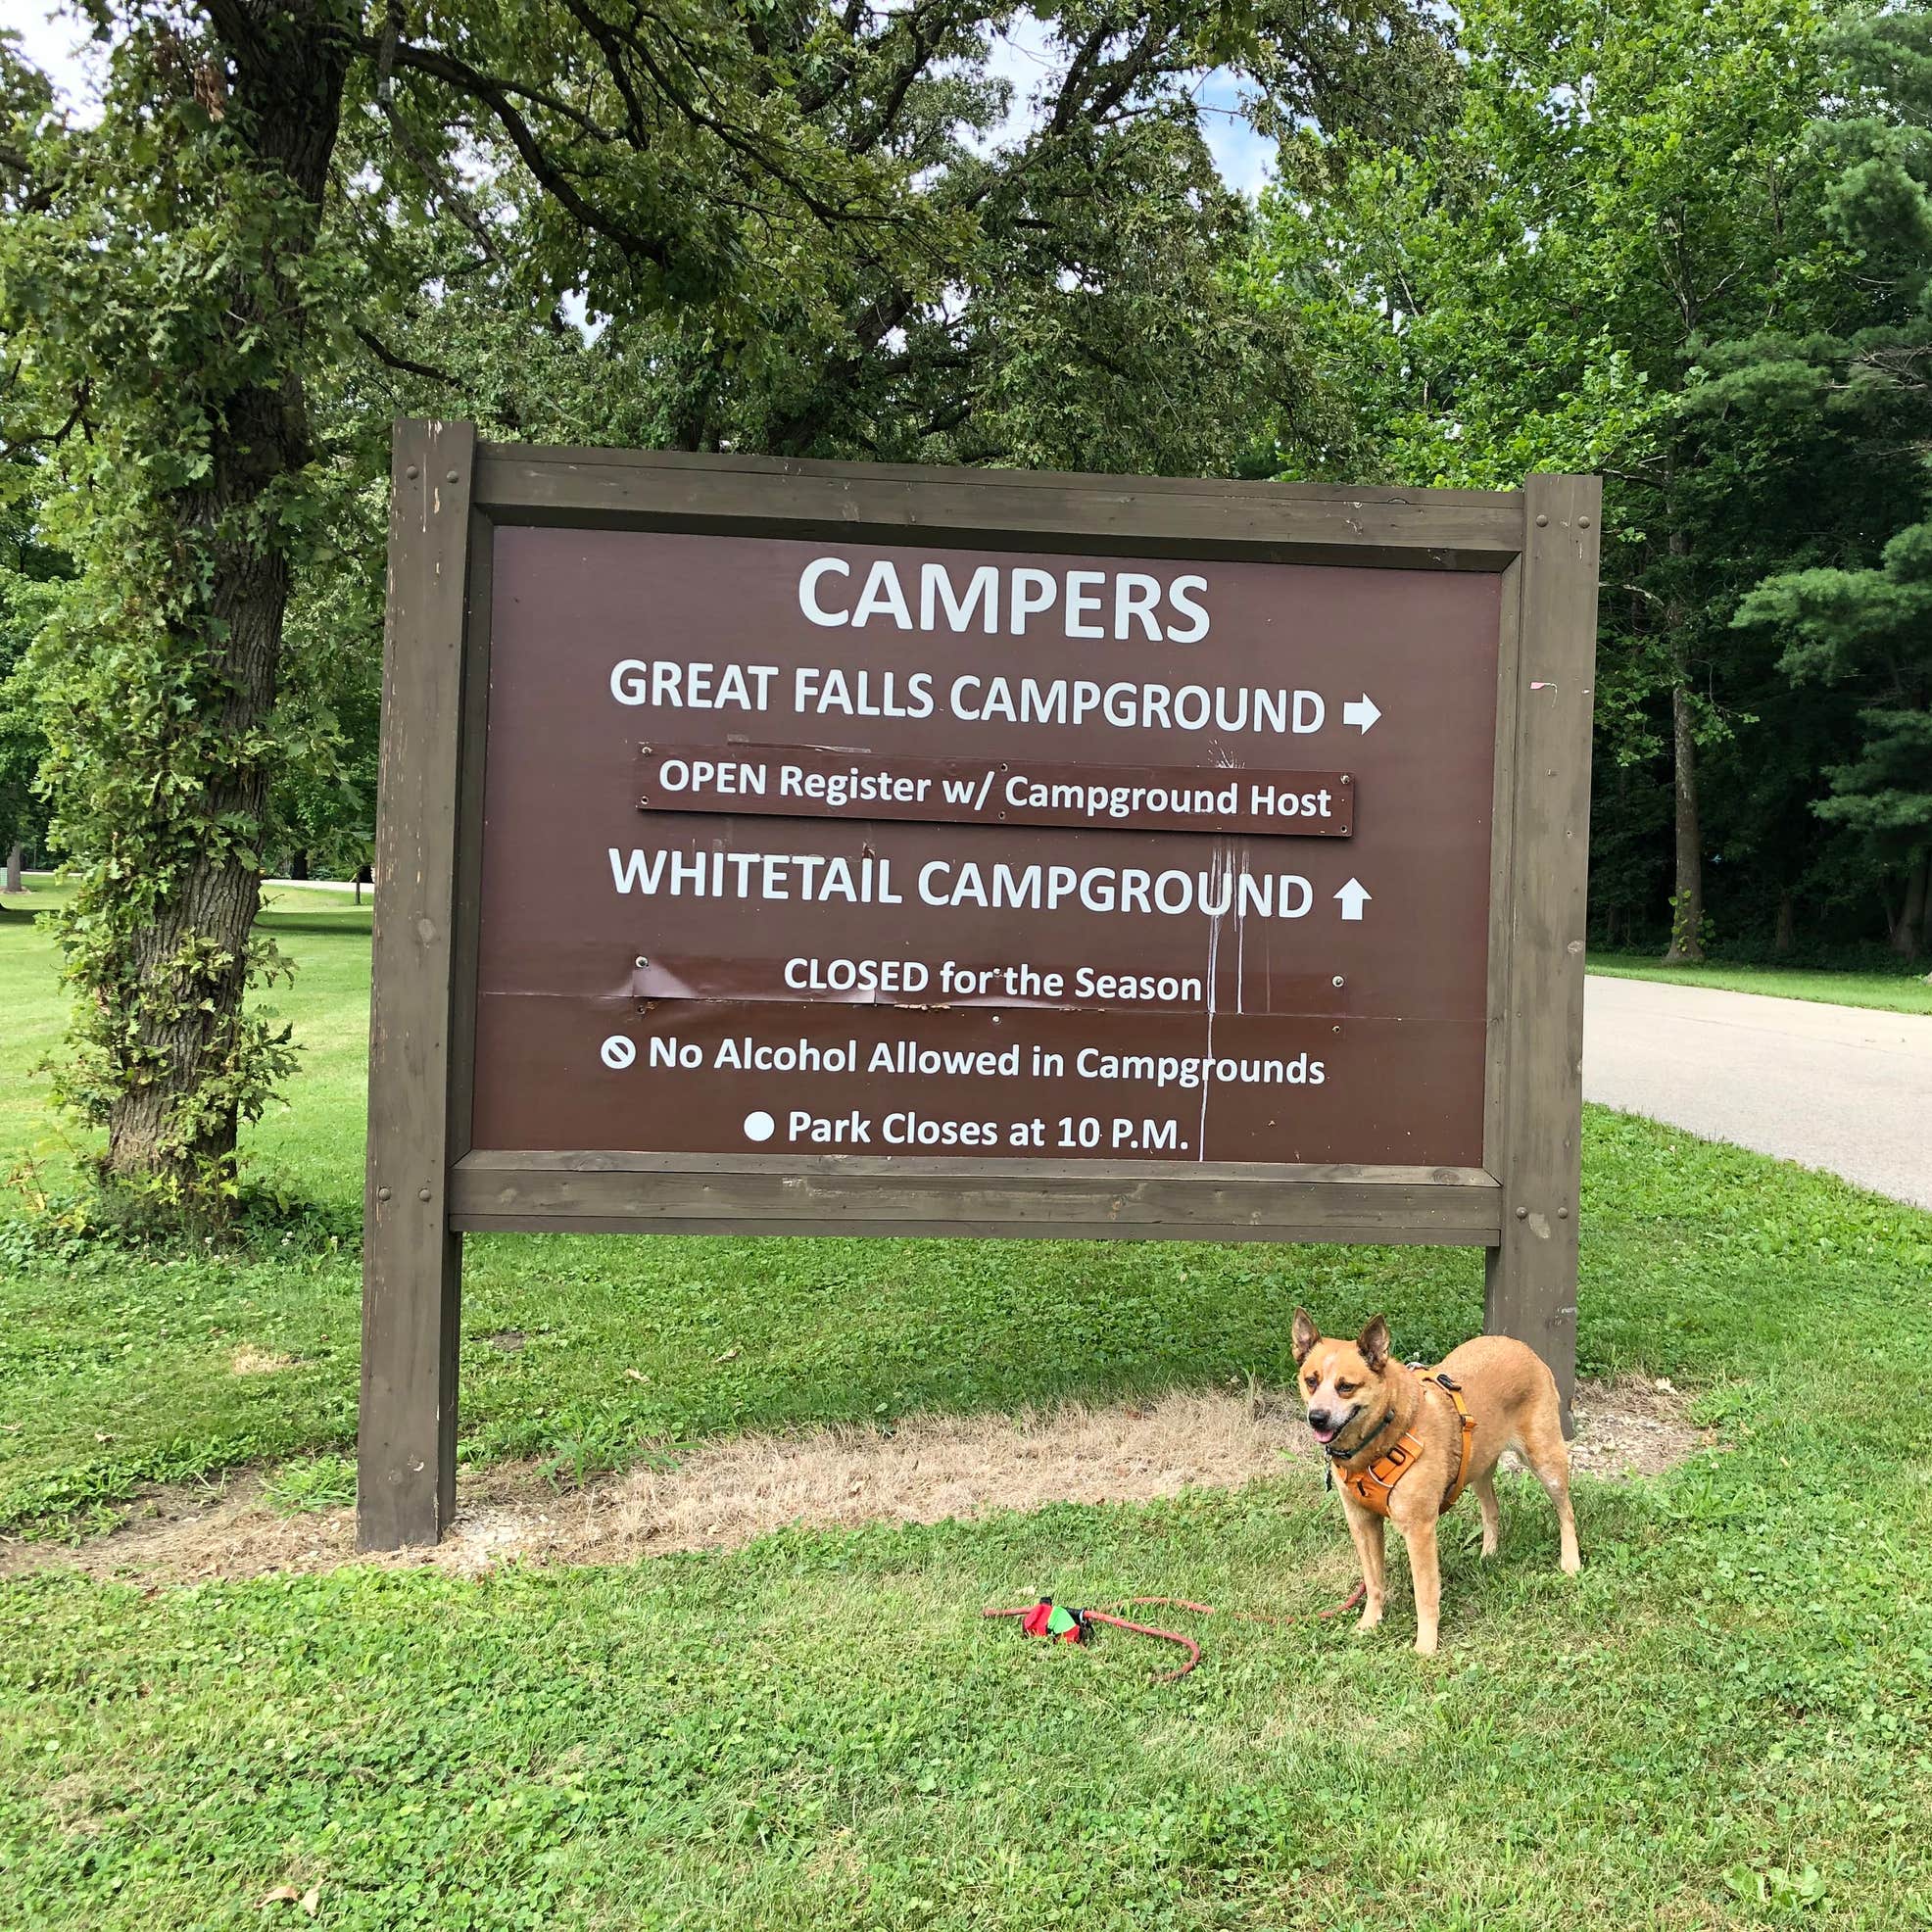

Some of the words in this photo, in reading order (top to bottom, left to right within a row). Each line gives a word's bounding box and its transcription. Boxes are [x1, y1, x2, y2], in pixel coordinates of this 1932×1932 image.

[798, 556, 1210, 644] CAMPERS
[609, 658, 780, 711] GREAT
[795, 667, 935, 718] FALLS
[950, 674, 1326, 734] CAMPGROUND
[659, 759, 767, 795] OPEN
[780, 765, 932, 806] Register
[942, 770, 995, 811] w/
[1005, 775, 1238, 818] Campground
[1251, 785, 1331, 817] Host
[608, 847, 903, 904] WHITETAIL
[918, 859, 1314, 919] CAMPGROUND
[784, 957, 929, 992] CLOSED
[940, 960, 993, 994] for
[1004, 963, 1064, 997] the
[1075, 967, 1201, 1001] Season
[650, 1037, 703, 1069] No
[713, 1037, 856, 1072] Alcohol
[867, 1040, 1020, 1076] Allowed
[1033, 1045, 1064, 1078] in
[1076, 1046, 1326, 1089] Campgrounds
[789, 1110, 871, 1143] Park
[882, 1111, 998, 1146] Closes
[1009, 1118, 1045, 1147] at
[1057, 1117, 1100, 1148] 10
[1112, 1118, 1188, 1150] P.M.
